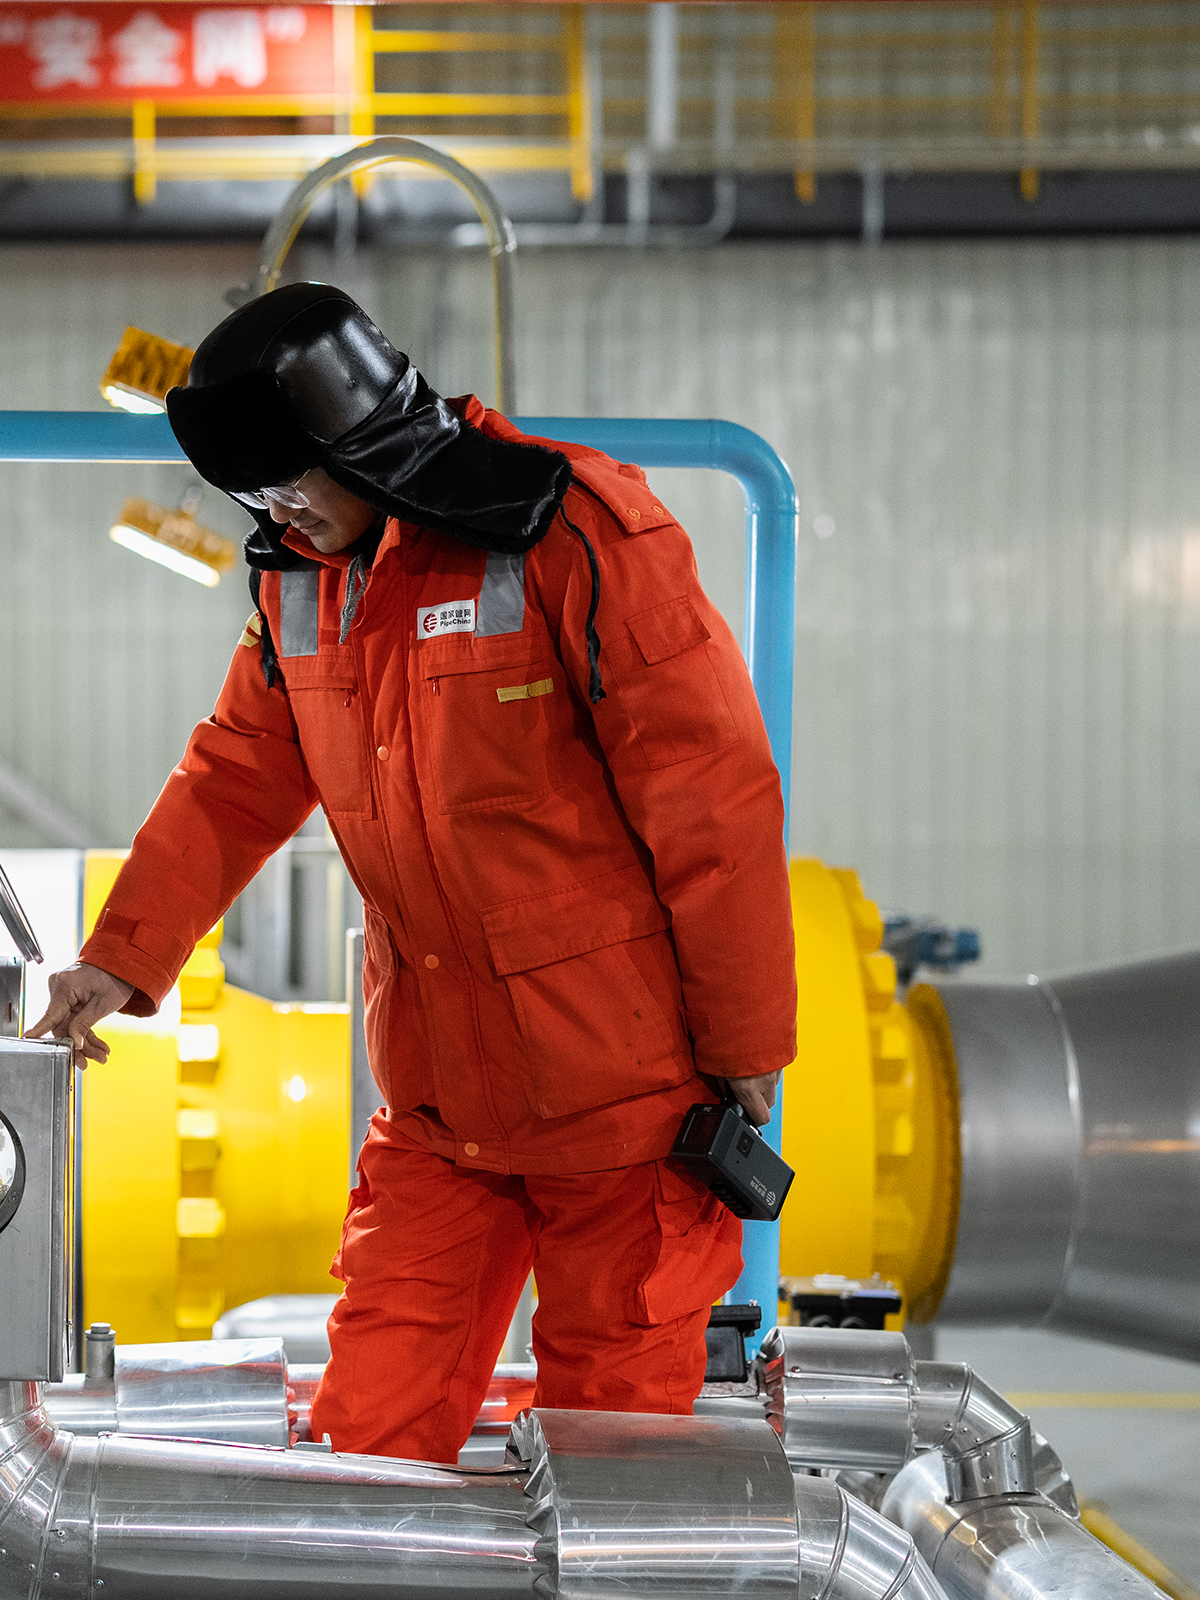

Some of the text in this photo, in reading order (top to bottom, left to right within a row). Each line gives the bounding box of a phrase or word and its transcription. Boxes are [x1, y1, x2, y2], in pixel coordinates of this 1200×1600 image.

[440, 609, 471, 620] 国家管网
[440, 619, 471, 627] PipeChina
